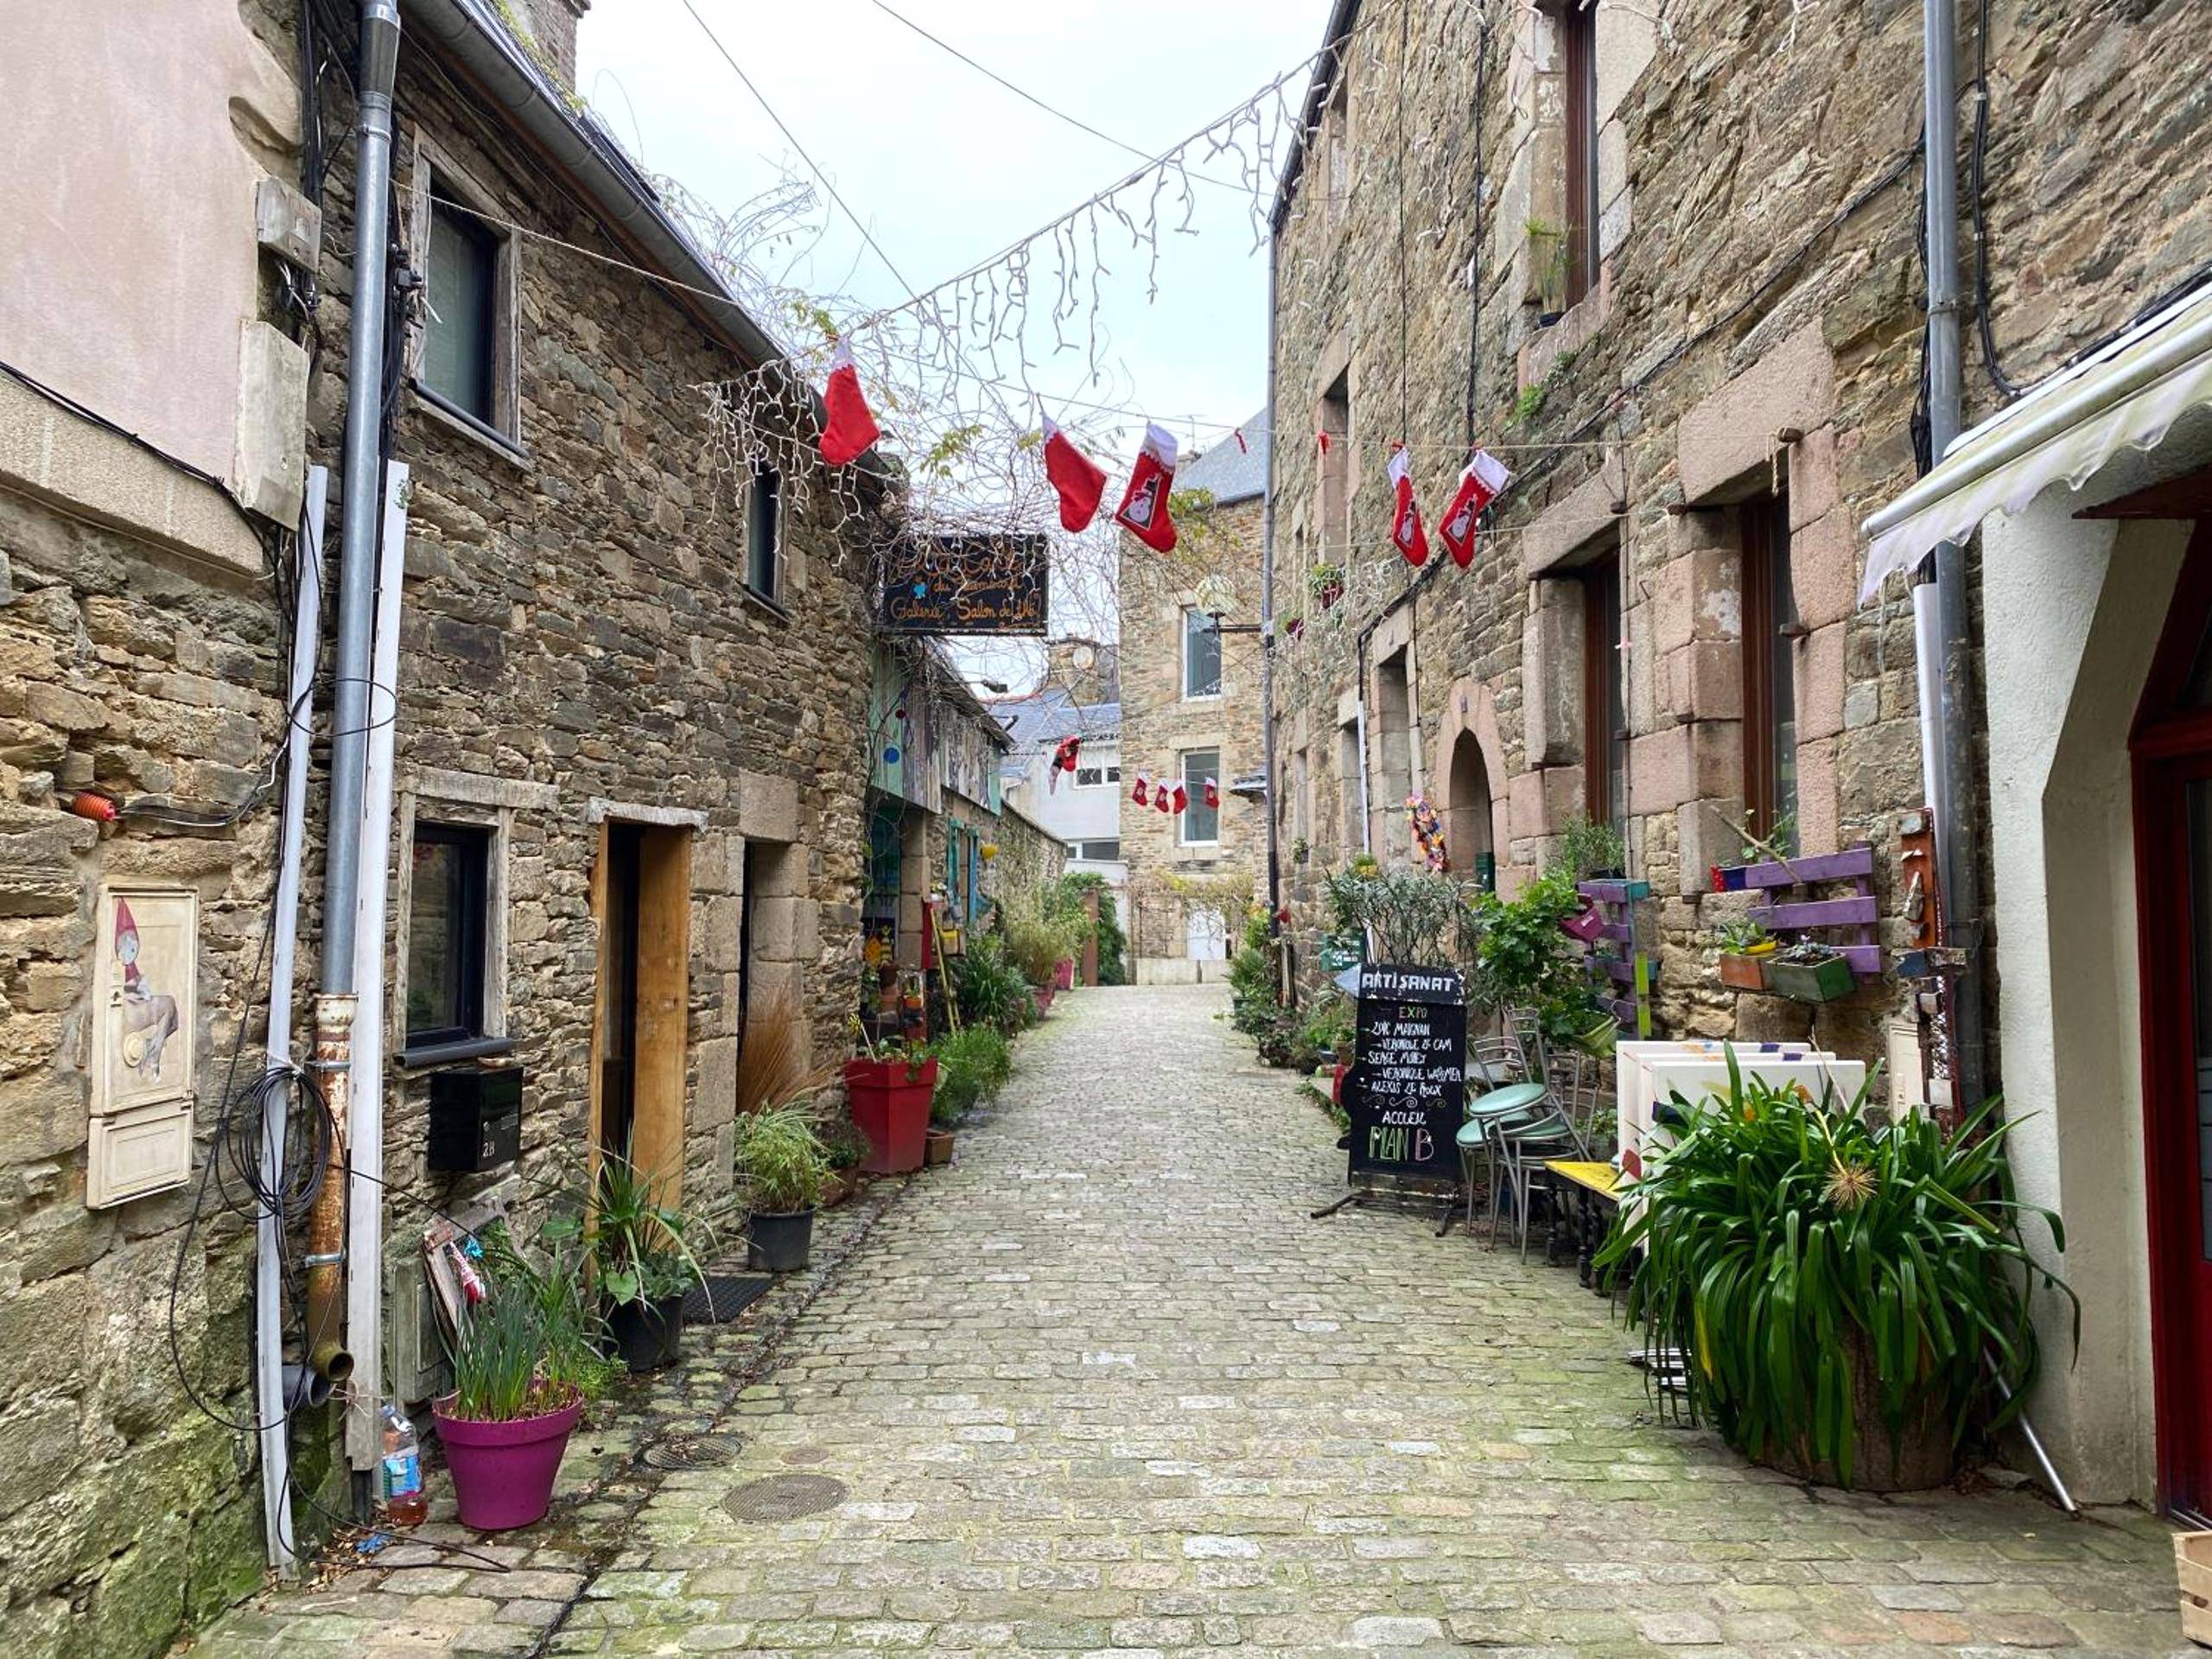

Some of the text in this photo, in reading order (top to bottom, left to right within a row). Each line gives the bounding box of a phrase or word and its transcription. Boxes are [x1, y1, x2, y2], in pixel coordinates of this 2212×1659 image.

[1361, 971, 1456, 993] ARTISANAT
[1399, 1007, 1427, 1019] EXPO
[1433, 1038, 1452, 1052] CAM
[1382, 1110, 1427, 1125] ACCUEIL
[1369, 1126, 1434, 1161] PLAN B
